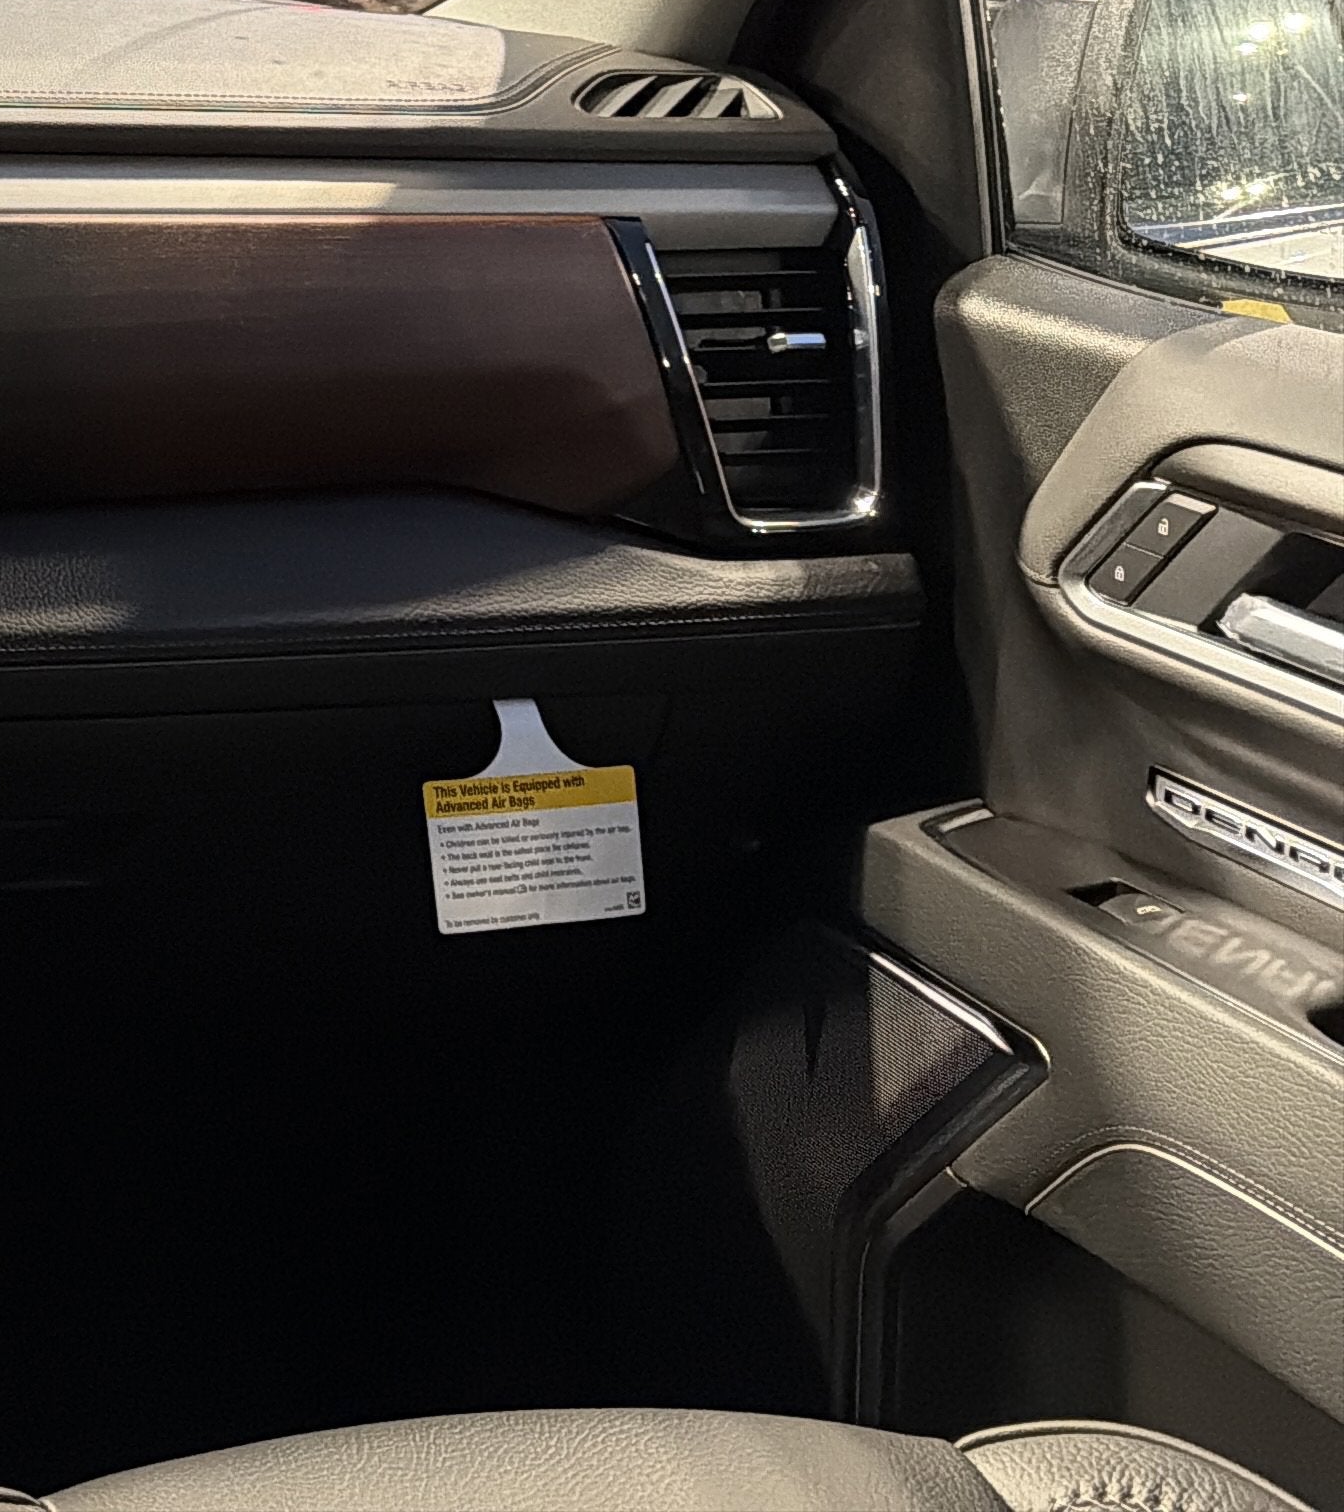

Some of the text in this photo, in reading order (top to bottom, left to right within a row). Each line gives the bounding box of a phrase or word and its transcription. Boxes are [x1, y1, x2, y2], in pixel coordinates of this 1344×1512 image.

[434, 775, 585, 799] This Vehicle is Equipped with
[435, 794, 536, 813] Advanced Air Bags
[475, 819, 509, 830] Advanced
[1164, 788, 1344, 884] DENA
